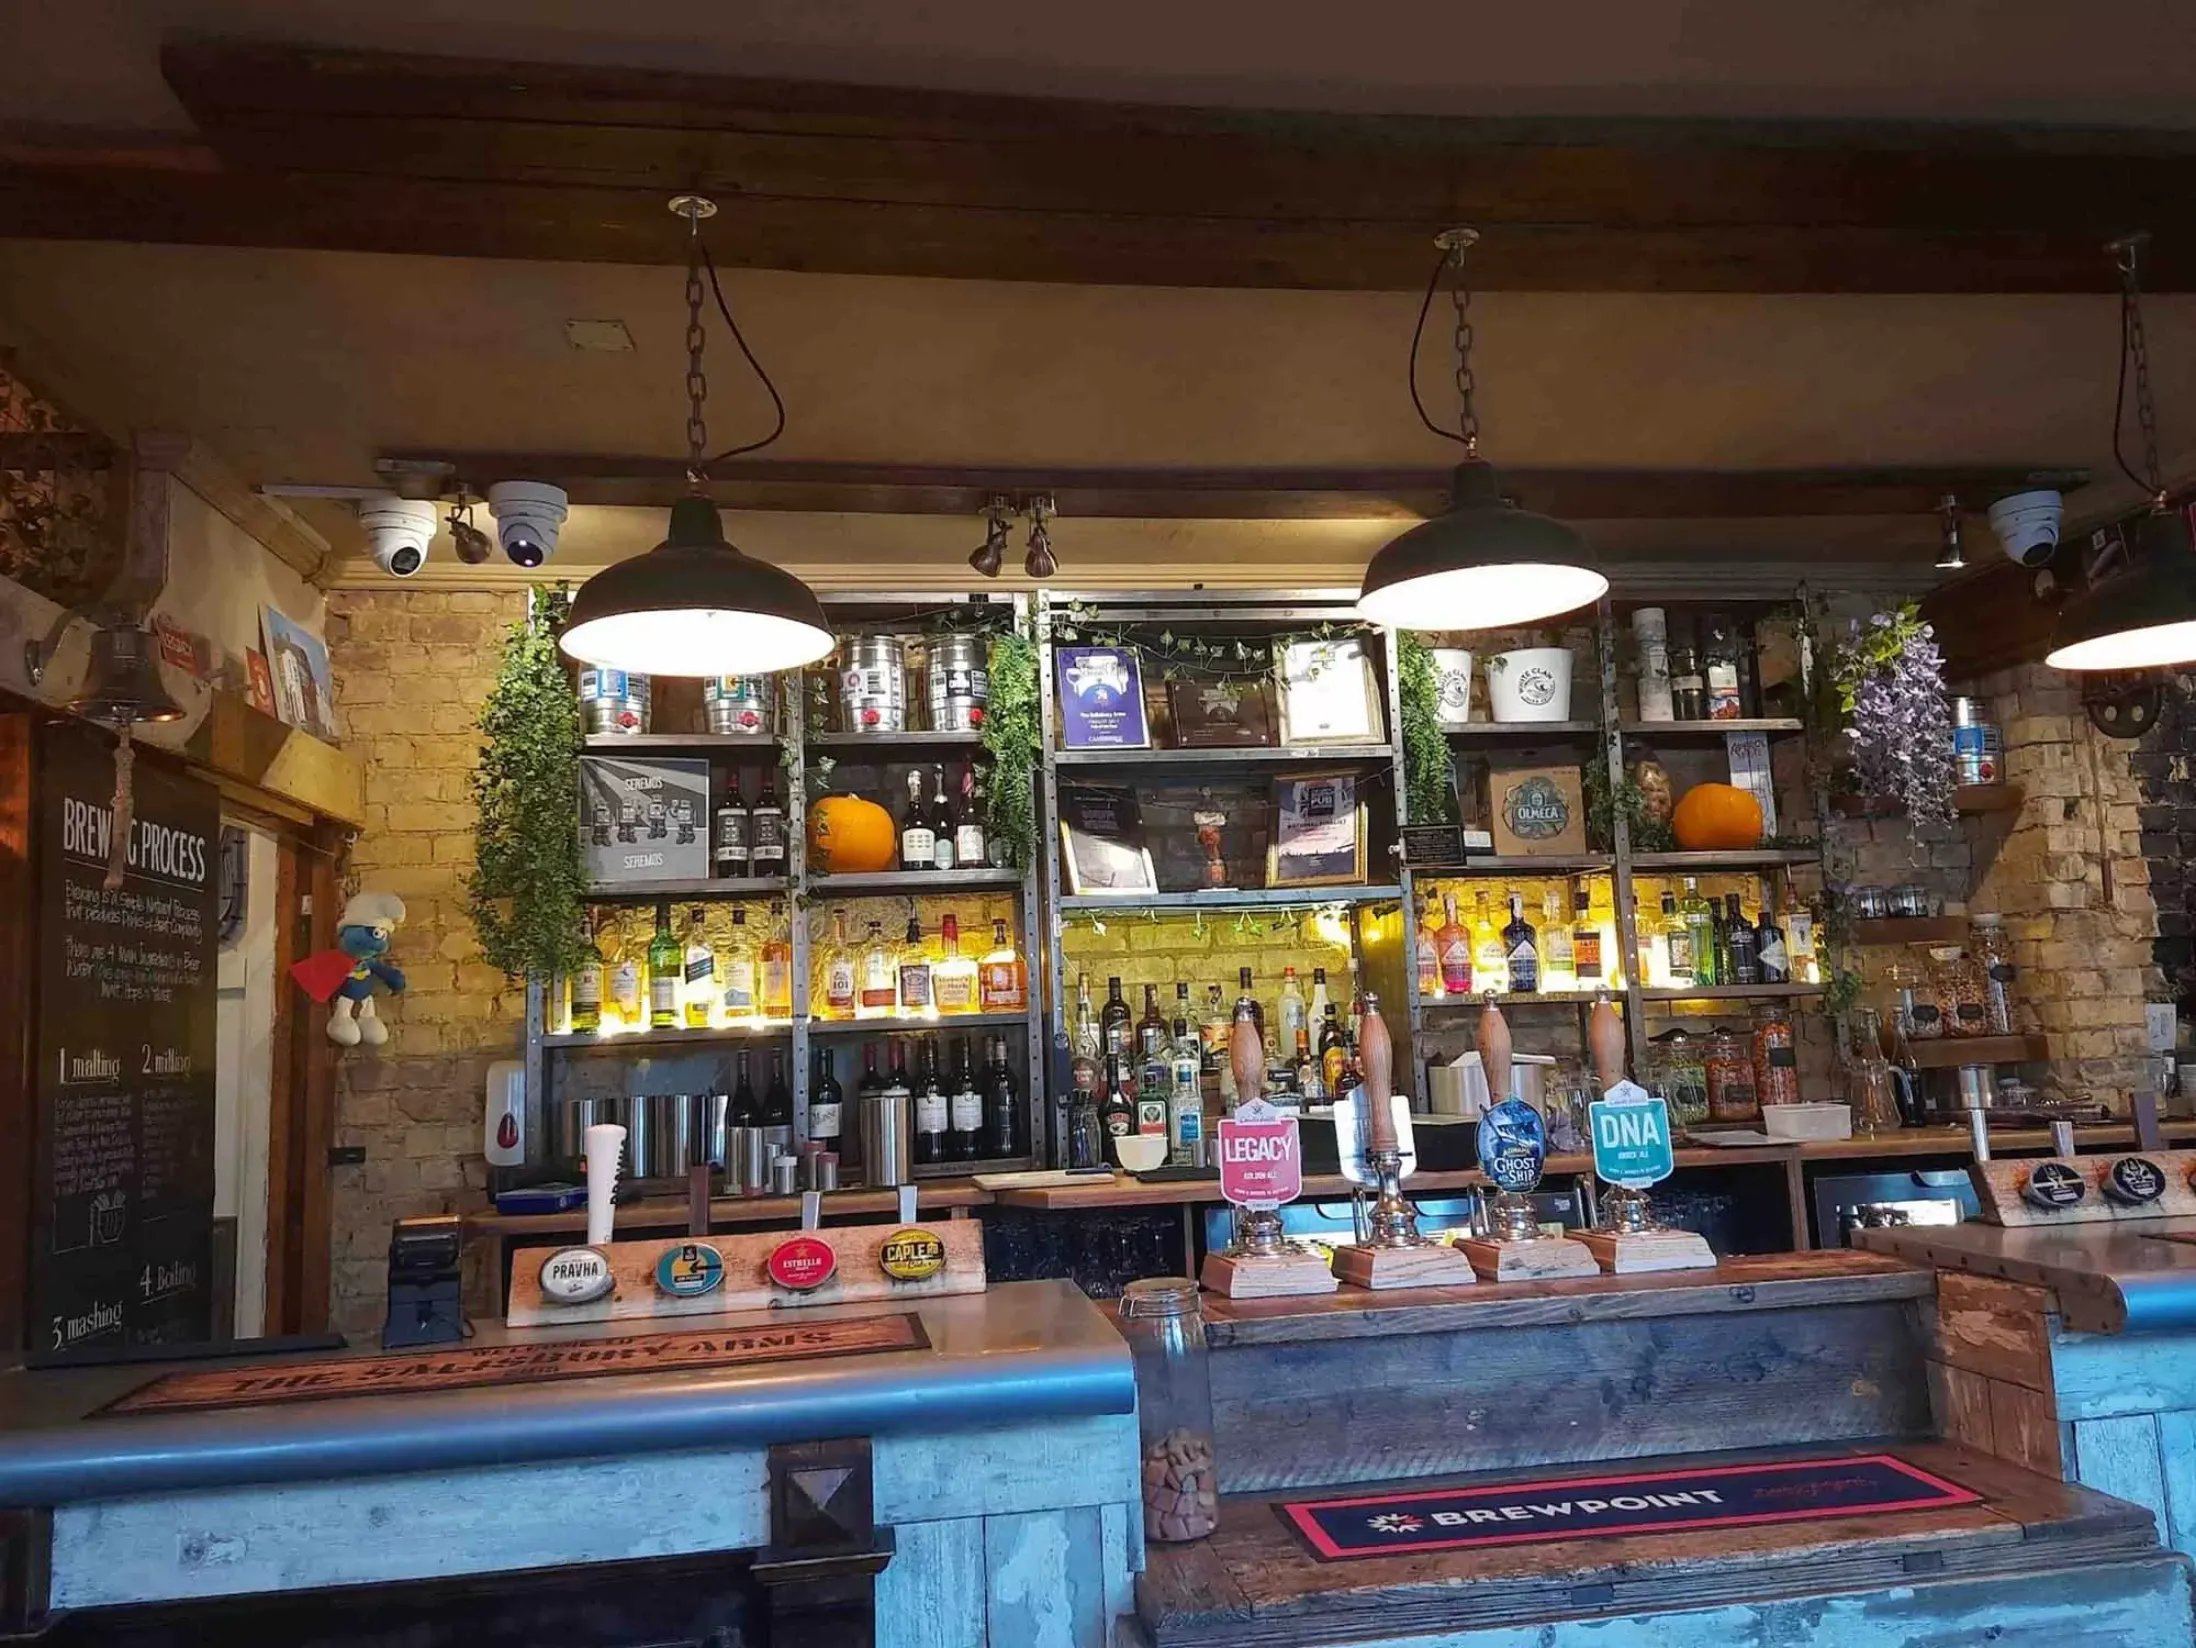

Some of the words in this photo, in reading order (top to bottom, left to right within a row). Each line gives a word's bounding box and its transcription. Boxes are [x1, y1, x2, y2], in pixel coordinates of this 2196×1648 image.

[1519, 670, 1531, 693] WHITE
[1531, 667, 1553, 679] CLAW
[1518, 806, 1559, 820] OLMECA
[63, 797, 138, 866] BREWG
[142, 821, 205, 883] PROCESS
[72, 1049, 121, 1086] malting
[141, 1043, 152, 1074] 2
[155, 1048, 192, 1081] milling
[1600, 1112, 1661, 1149] DNA
[1224, 1136, 1293, 1163] LEGACY
[1494, 1157, 1536, 1174] GHOST
[1508, 1169, 1535, 1183] SHIP
[783, 1257, 822, 1269] ESTRELLA
[886, 1243, 926, 1261] CAPLE
[157, 1260, 197, 1292] Boiling
[552, 1262, 599, 1279] PRAVHA
[52, 1315, 63, 1351] 3
[67, 1300, 123, 1341] mashing
[233, 1371, 344, 1393] THE
[688, 1330, 837, 1353] ARMS
[1430, 1488, 1727, 1528] BREWPOINT
